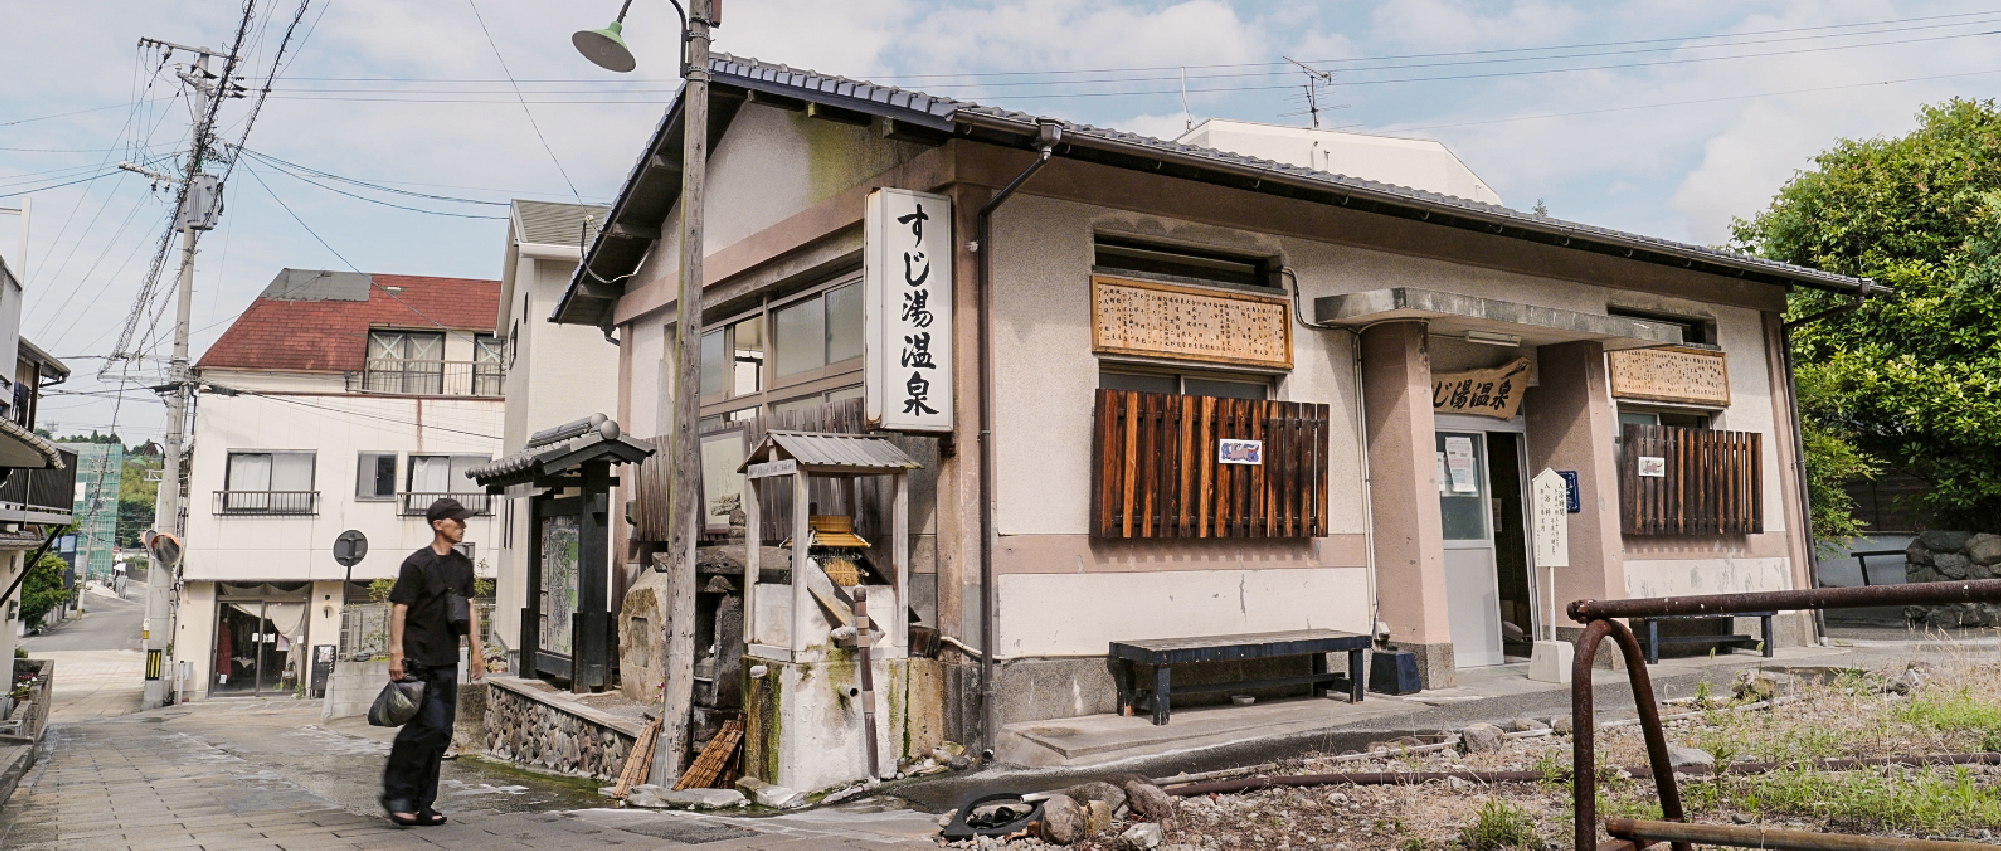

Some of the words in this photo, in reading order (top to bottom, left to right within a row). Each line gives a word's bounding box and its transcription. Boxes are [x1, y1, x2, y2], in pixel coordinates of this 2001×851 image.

[897, 203, 940, 416] すじ湯温泉
[1431, 379, 1511, 410] じ湯温泉
